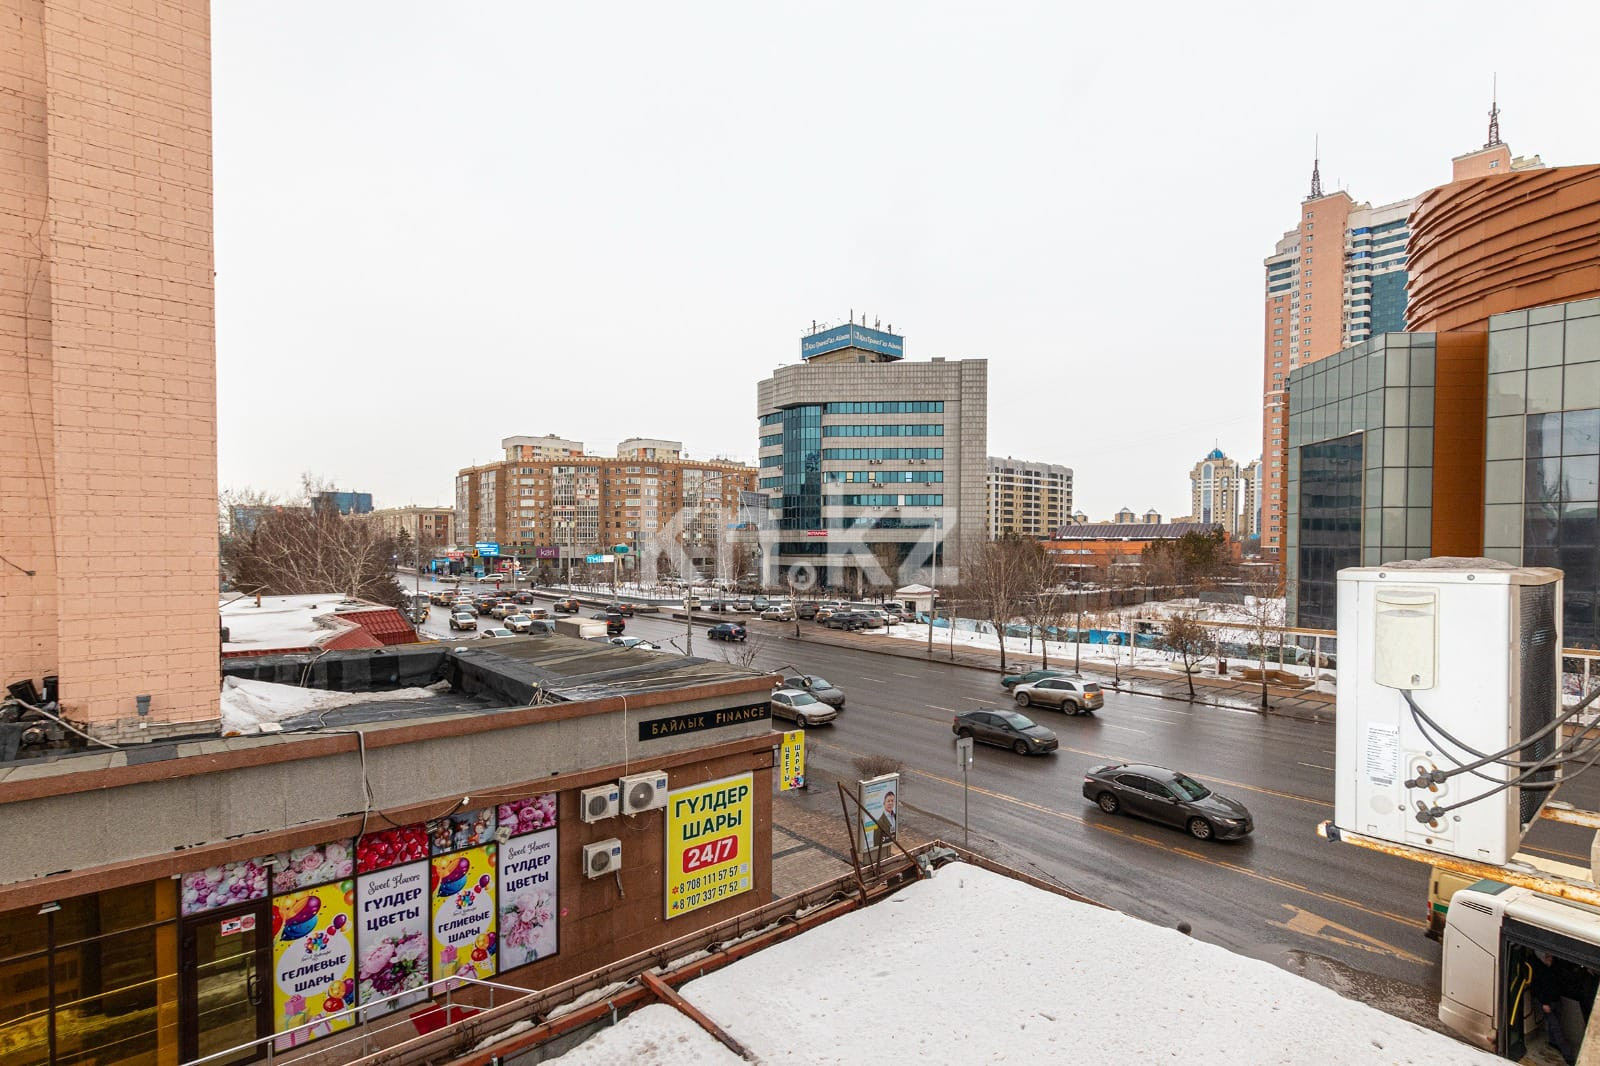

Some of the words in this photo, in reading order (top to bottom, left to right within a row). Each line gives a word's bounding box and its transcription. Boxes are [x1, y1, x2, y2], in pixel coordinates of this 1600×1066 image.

[716, 706, 765, 724] FINANCE
[675, 785, 749, 818] ГҮЛДЕР
[682, 810, 742, 841] ШАРЫ
[508, 845, 526, 860] Sweet
[527, 841, 551, 855] Flowers
[687, 838, 733, 869] 24/7
[504, 854, 551, 876] ГҮЛДЕР
[368, 877, 390, 896] Sweet
[391, 872, 421, 889] Flowers
[506, 871, 549, 893] ЦВЕТЫ
[680, 882, 685, 894] 8
[686, 877, 701, 891] 708
[703, 872, 716, 886] 111
[718, 869, 727, 881] 57
[729, 865, 738, 877] 57
[364, 887, 422, 913] ГҮЛДЕР
[680, 899, 685, 910] 8
[686, 893, 701, 908] 707
[703, 888, 716, 901] 337
[718, 884, 727, 897] 57
[729, 880, 738, 893] 52
[366, 906, 420, 932] ЦВЕТЫ
[438, 910, 490, 934] ГЕЛИЕВЫЕ
[448, 926, 481, 944] ШАРЫ
[281, 954, 347, 982] ГЕЛИЕВЫЕ
[294, 972, 335, 993] ШАРЫ
